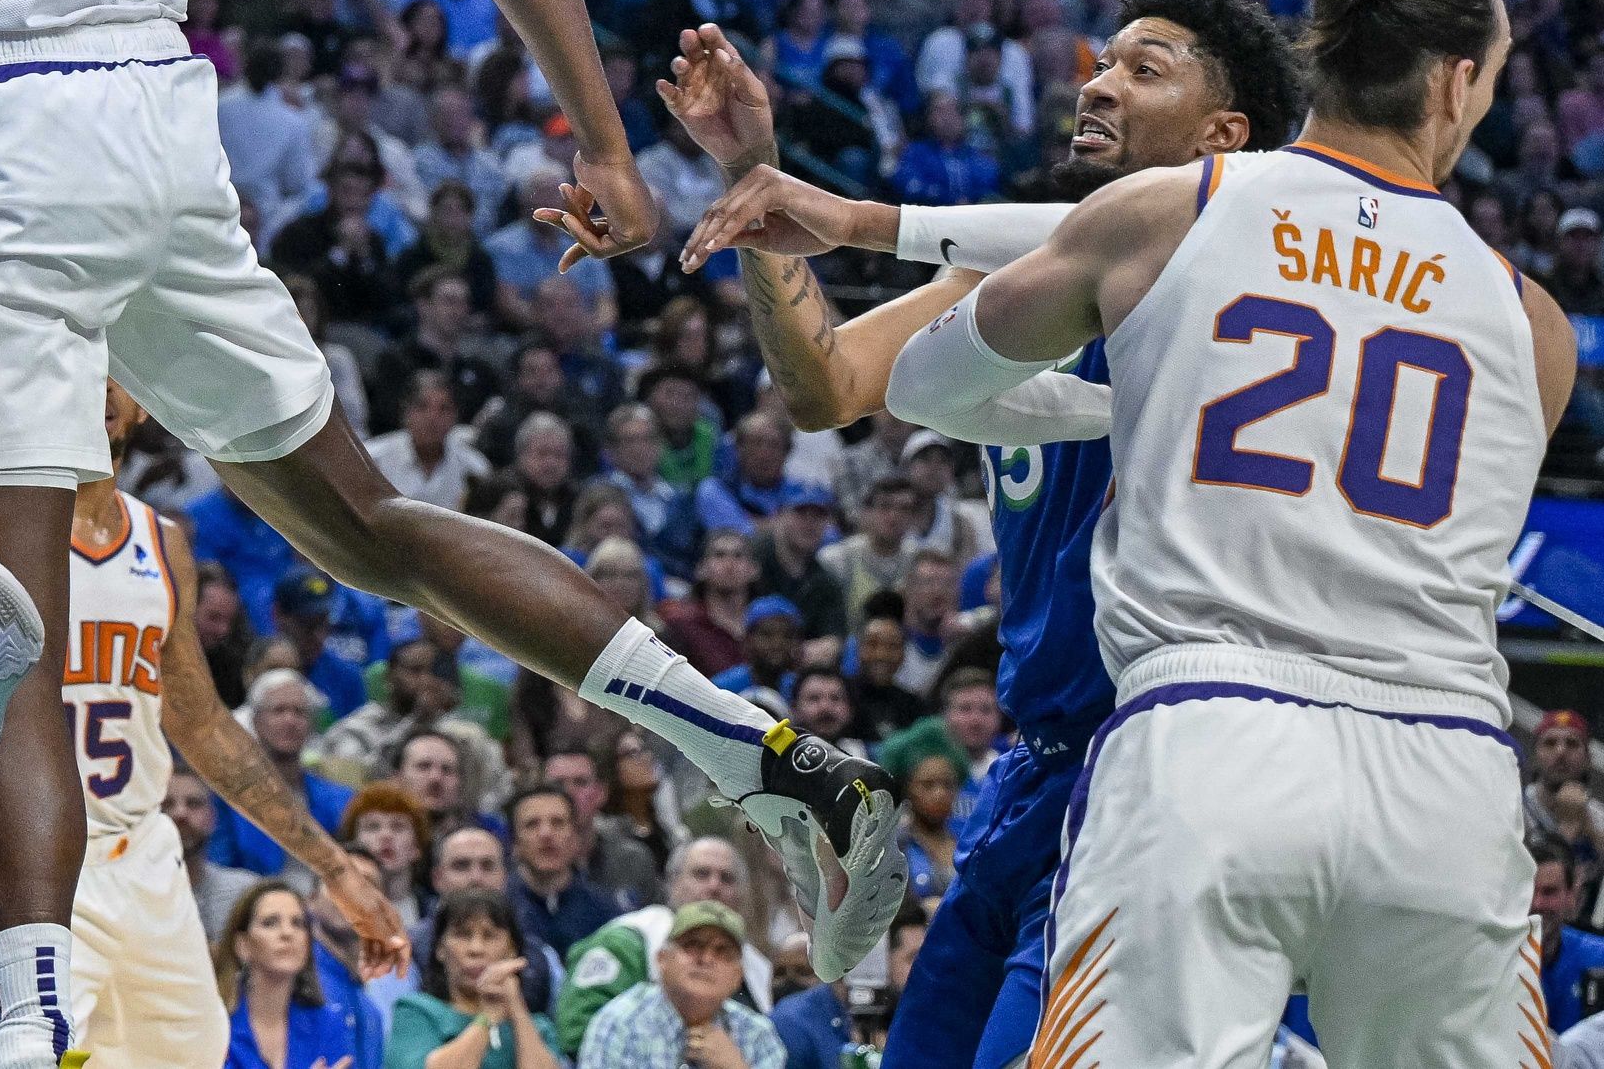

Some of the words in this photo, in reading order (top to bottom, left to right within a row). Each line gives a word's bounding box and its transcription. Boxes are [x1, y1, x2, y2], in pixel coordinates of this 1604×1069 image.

[1271, 208, 1447, 314] ŠARIĆ
[1191, 292, 1474, 530] 20
[979, 444, 1044, 511] 5
[63, 620, 163, 696] UNS
